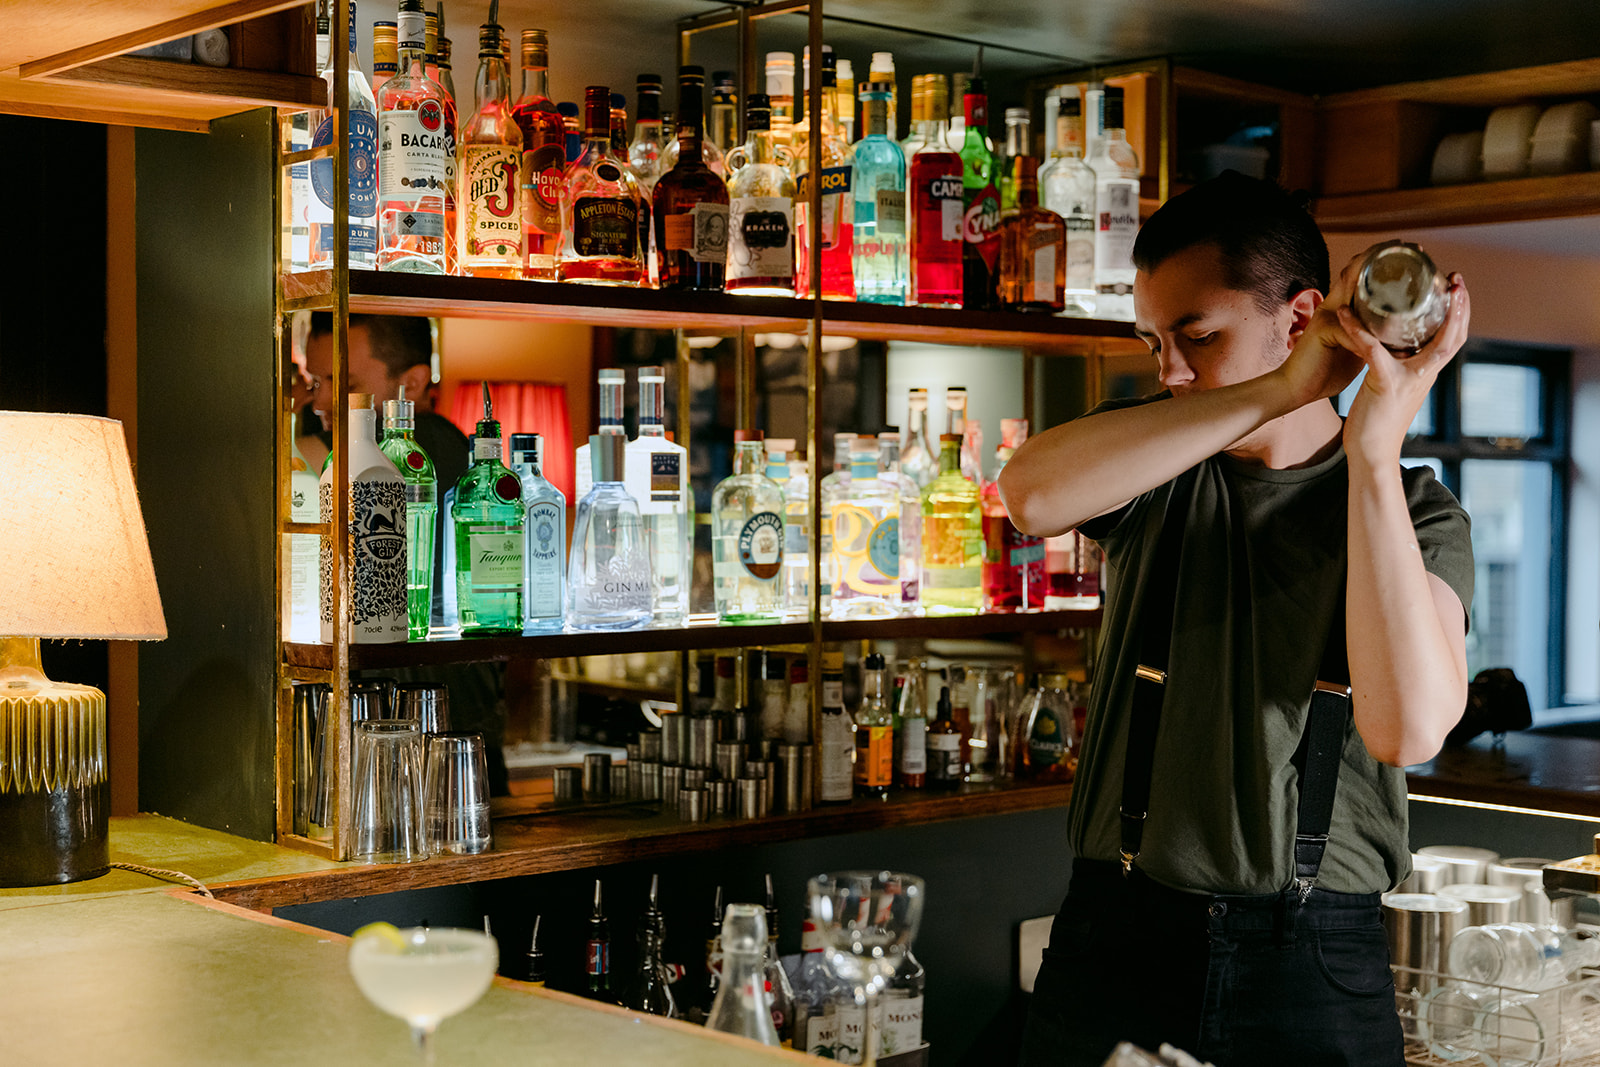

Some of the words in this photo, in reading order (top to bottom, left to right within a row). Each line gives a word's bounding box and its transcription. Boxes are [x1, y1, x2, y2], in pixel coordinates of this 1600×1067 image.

[799, 172, 848, 191] AROL
[470, 177, 499, 202] OLD
[580, 203, 616, 220] APPLETON
[480, 221, 520, 232] SPICED
[745, 224, 784, 232] KRAKEN
[963, 203, 1001, 244] CYNA
[351, 229, 369, 238] RUM
[533, 508, 556, 520] BOMBAY
[740, 514, 781, 550] PLYMOUTH
[369, 539, 401, 550] FOREST
[378, 547, 395, 557] GIN
[532, 547, 557, 560] SAPPHIRE
[603, 582, 631, 593] GIN
